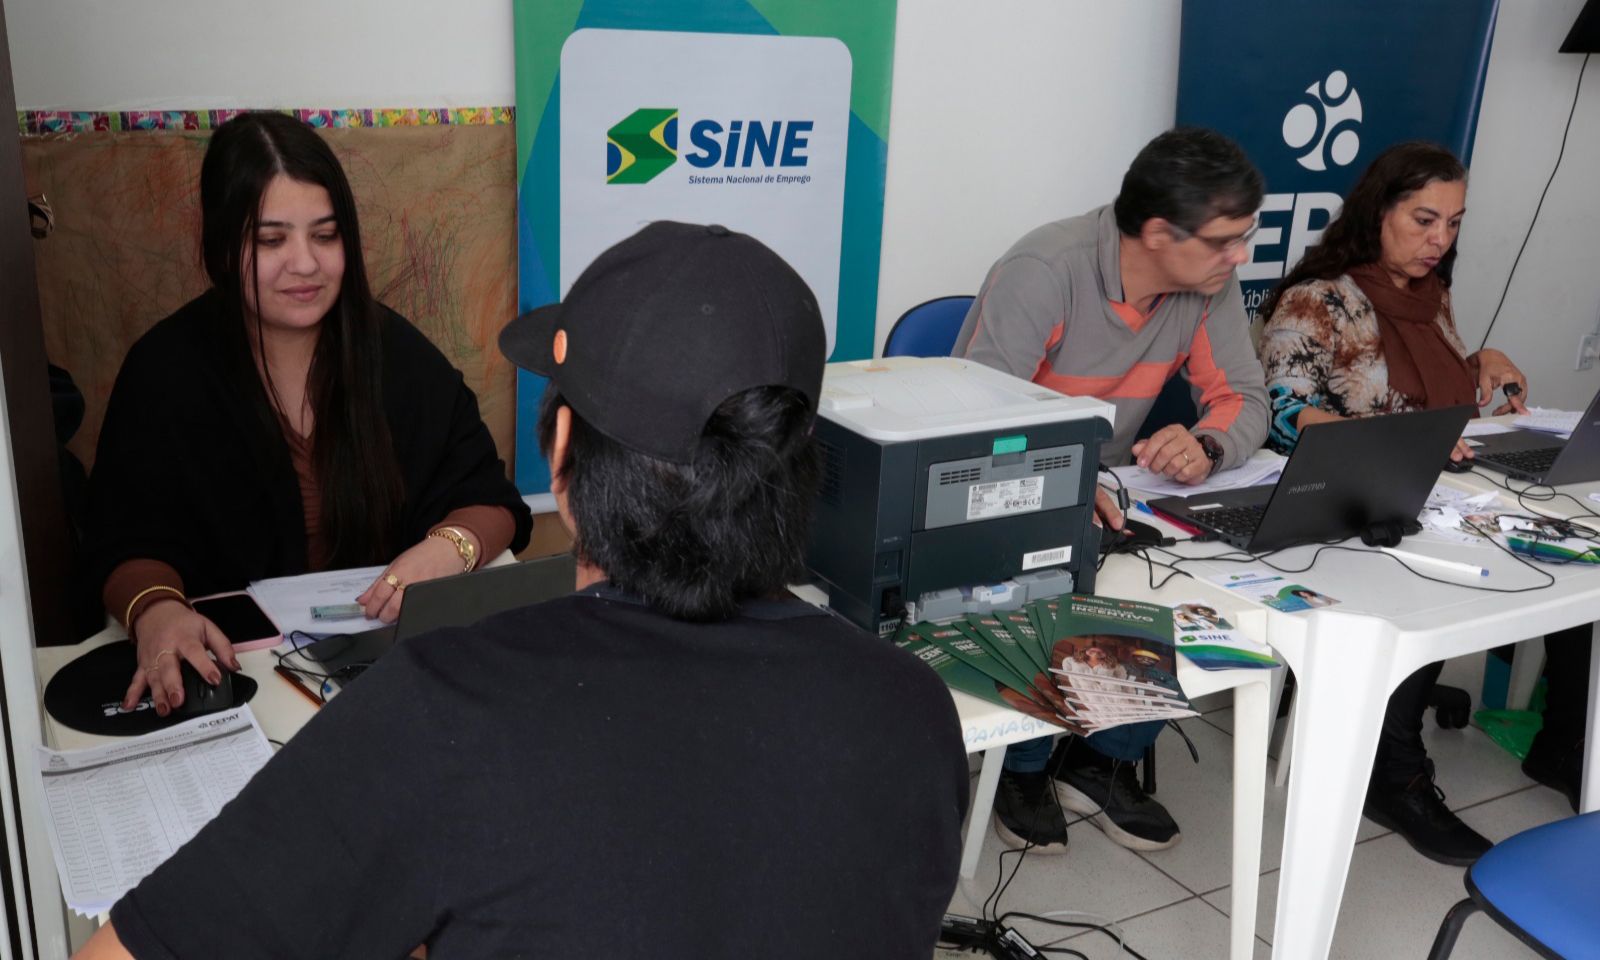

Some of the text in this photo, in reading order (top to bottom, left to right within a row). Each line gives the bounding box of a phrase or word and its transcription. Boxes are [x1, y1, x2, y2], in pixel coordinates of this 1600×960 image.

[688, 174, 811, 185] Sistema Nacional de Emprego
[1071, 605, 1154, 623] INCENTIVO
[1198, 633, 1232, 641] SINE
